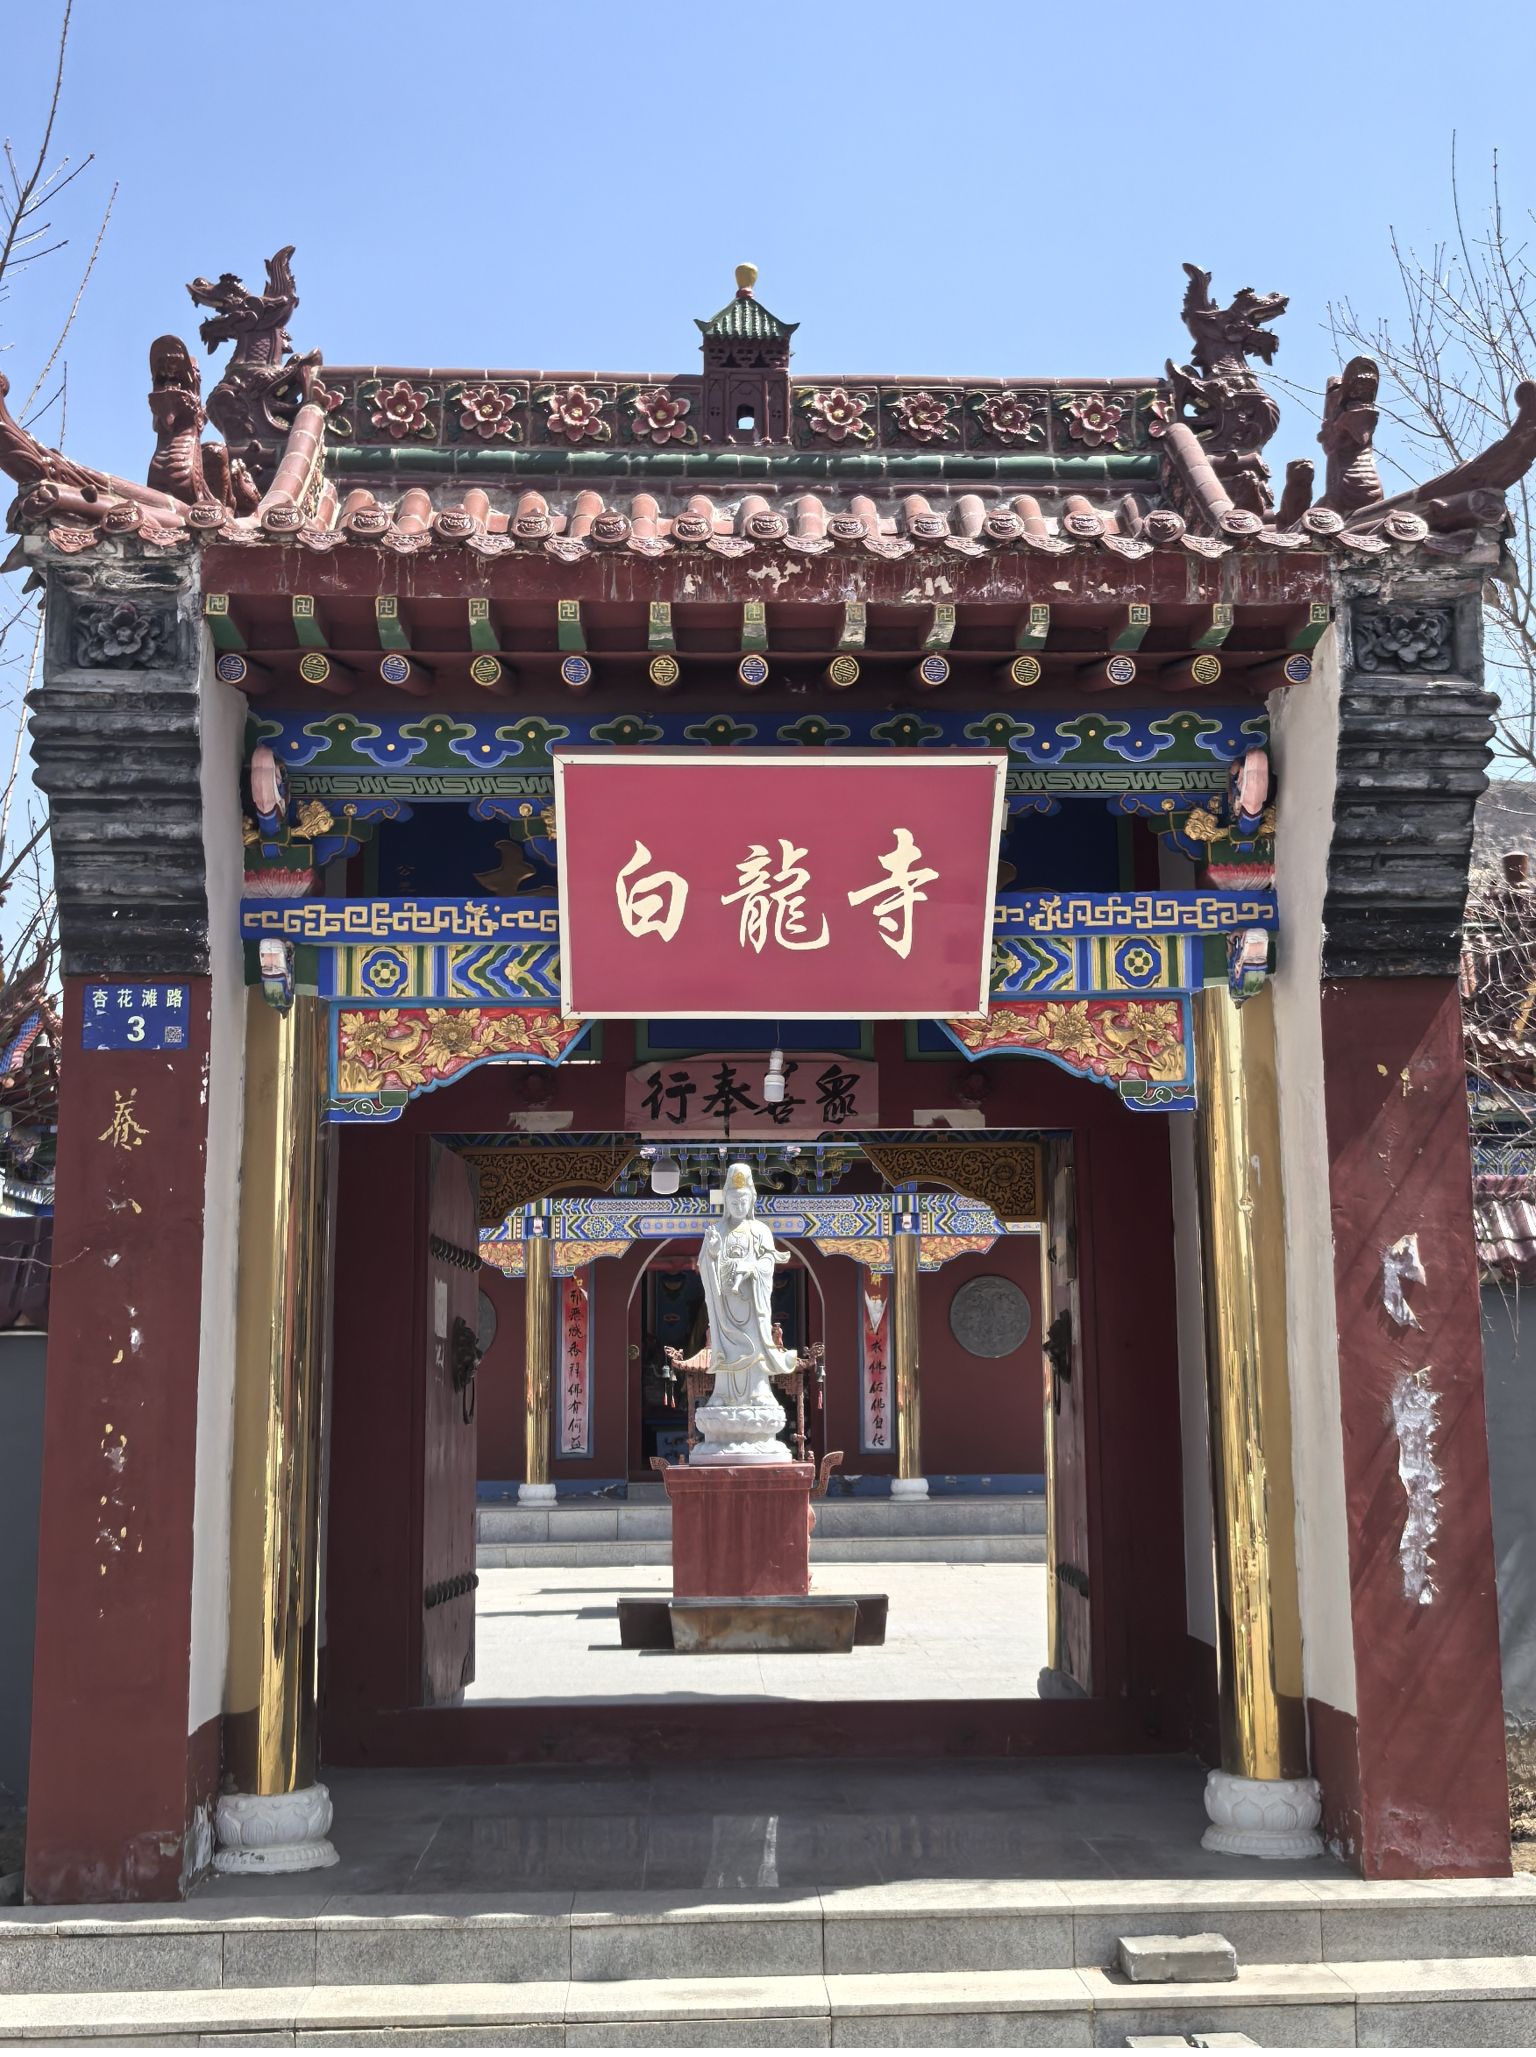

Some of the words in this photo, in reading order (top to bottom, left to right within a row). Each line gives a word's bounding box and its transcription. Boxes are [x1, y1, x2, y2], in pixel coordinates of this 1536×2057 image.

[615, 827, 940, 960] 白龍寺
[92, 988, 183, 1009] 杏花滩路
[126, 1015, 146, 1042] 3
